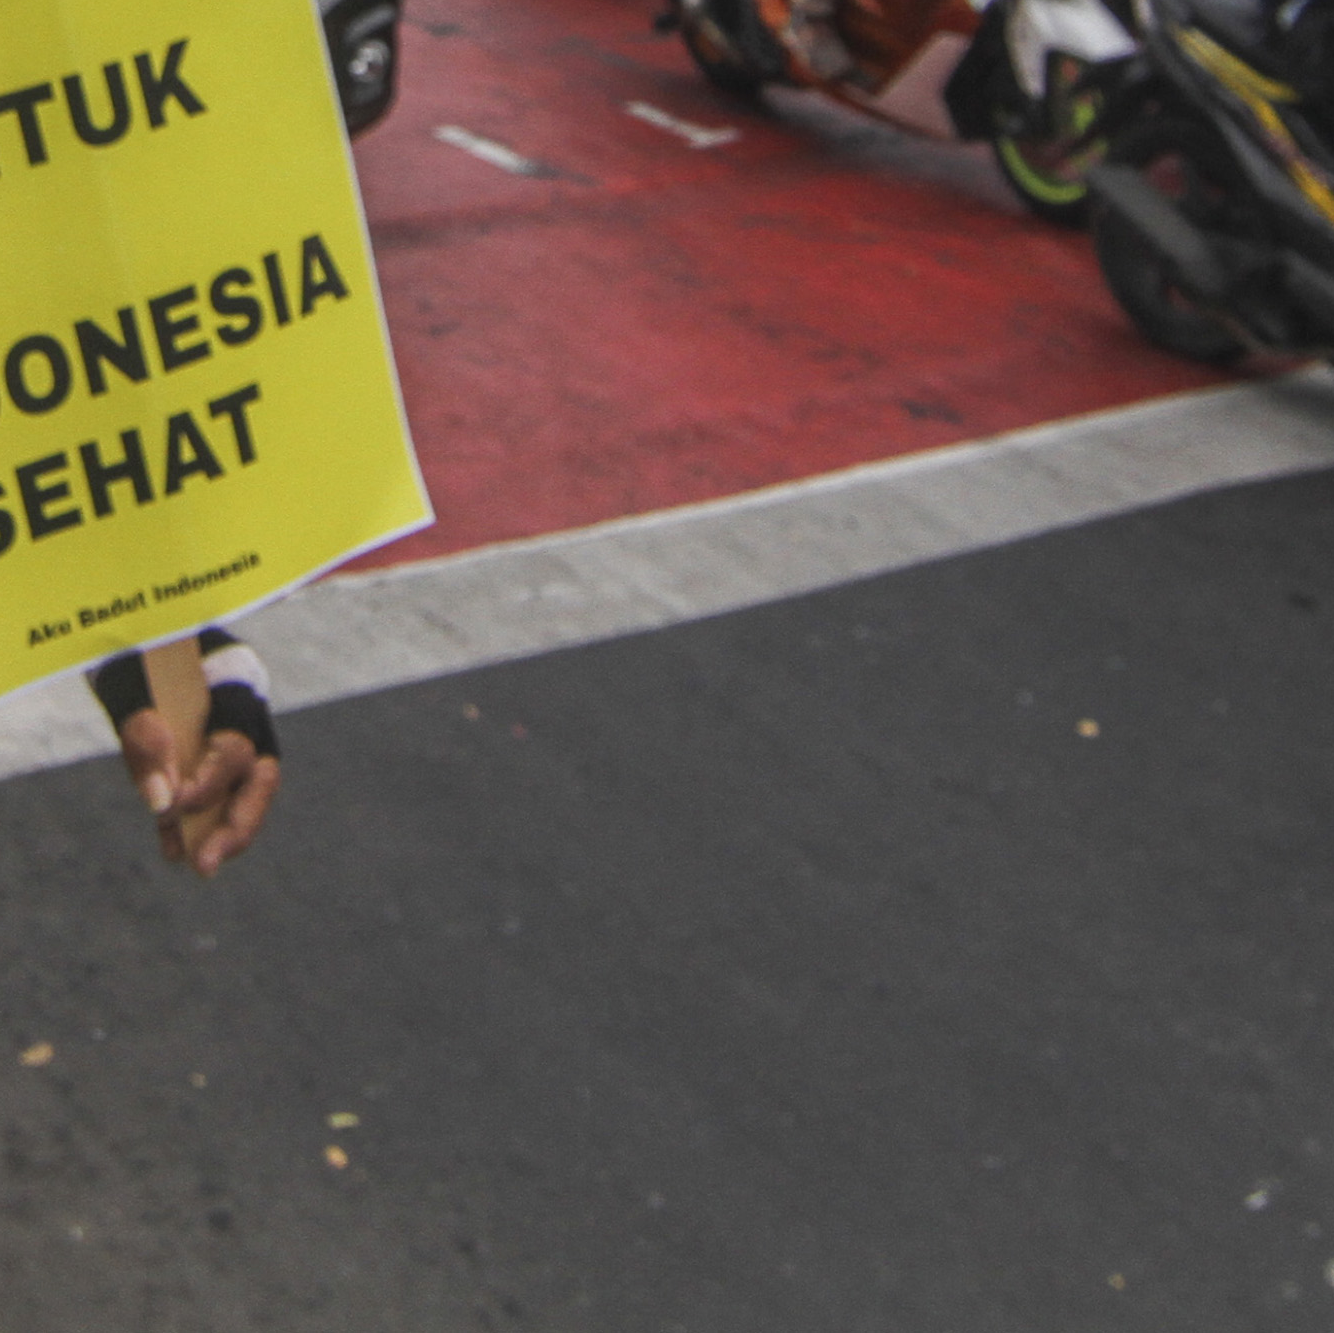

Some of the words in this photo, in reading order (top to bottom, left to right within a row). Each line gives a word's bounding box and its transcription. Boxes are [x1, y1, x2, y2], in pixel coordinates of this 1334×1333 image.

[28, 620, 72, 646] Aku
[77, 591, 147, 628] Badut
[152, 552, 260, 603] Indonesia
